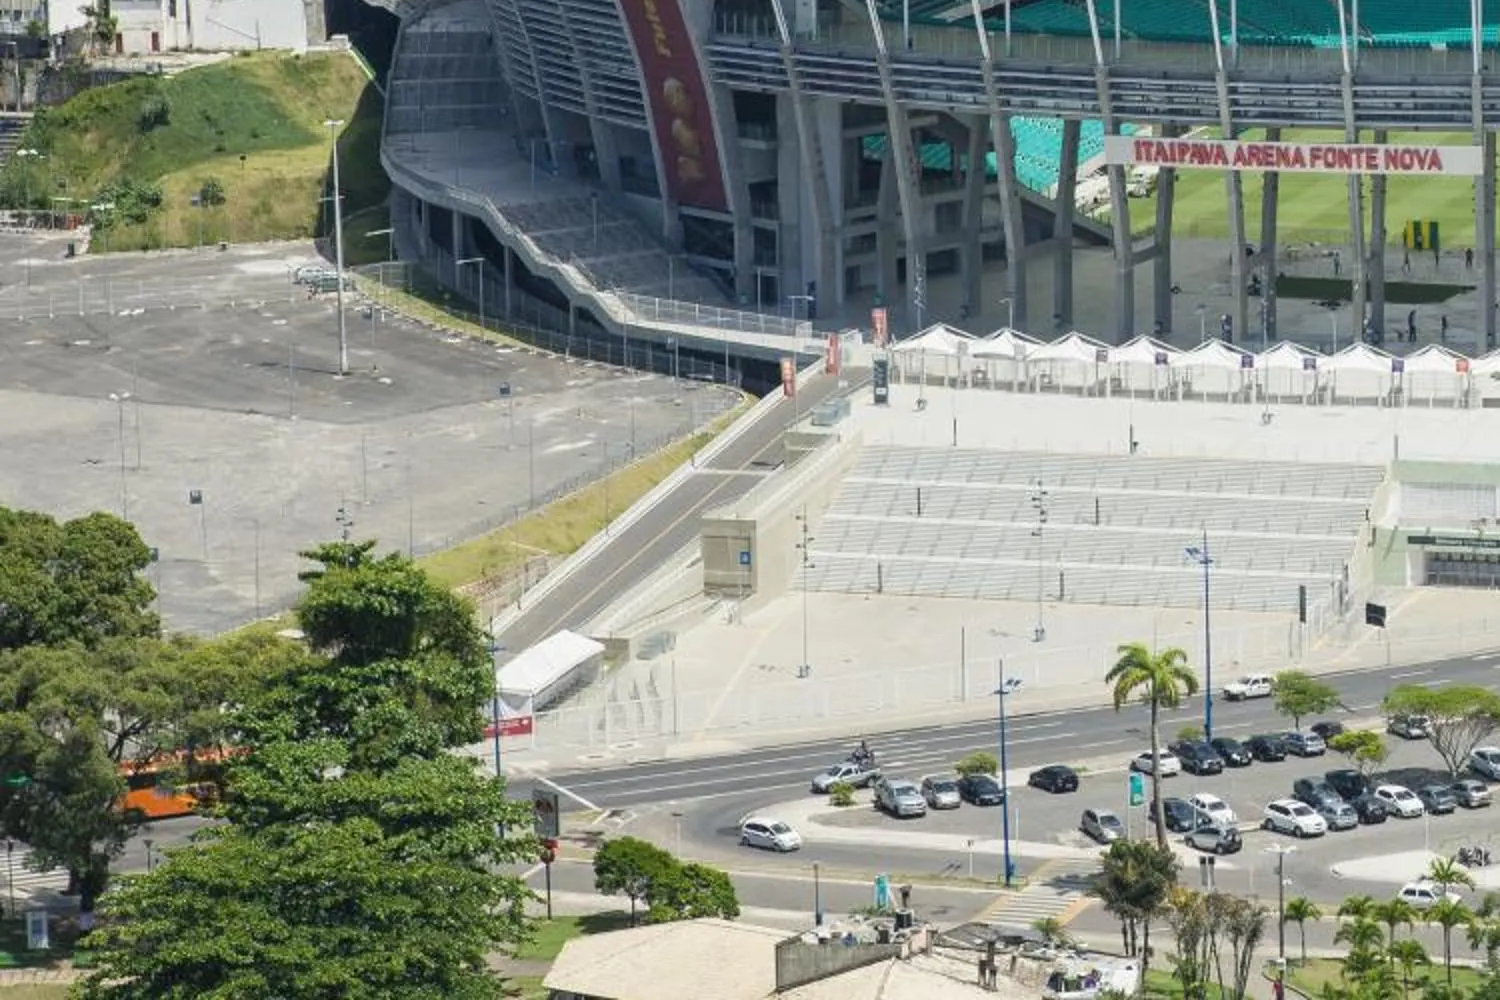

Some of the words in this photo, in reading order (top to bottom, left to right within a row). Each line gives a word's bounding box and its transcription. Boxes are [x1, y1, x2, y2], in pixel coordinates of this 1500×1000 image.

[1134, 140, 1229, 165] ITAIPAVA
[1233, 144, 1306, 168] ARENA
[1309, 147, 1378, 170] FONTE
[1384, 148, 1443, 171] NOVA
